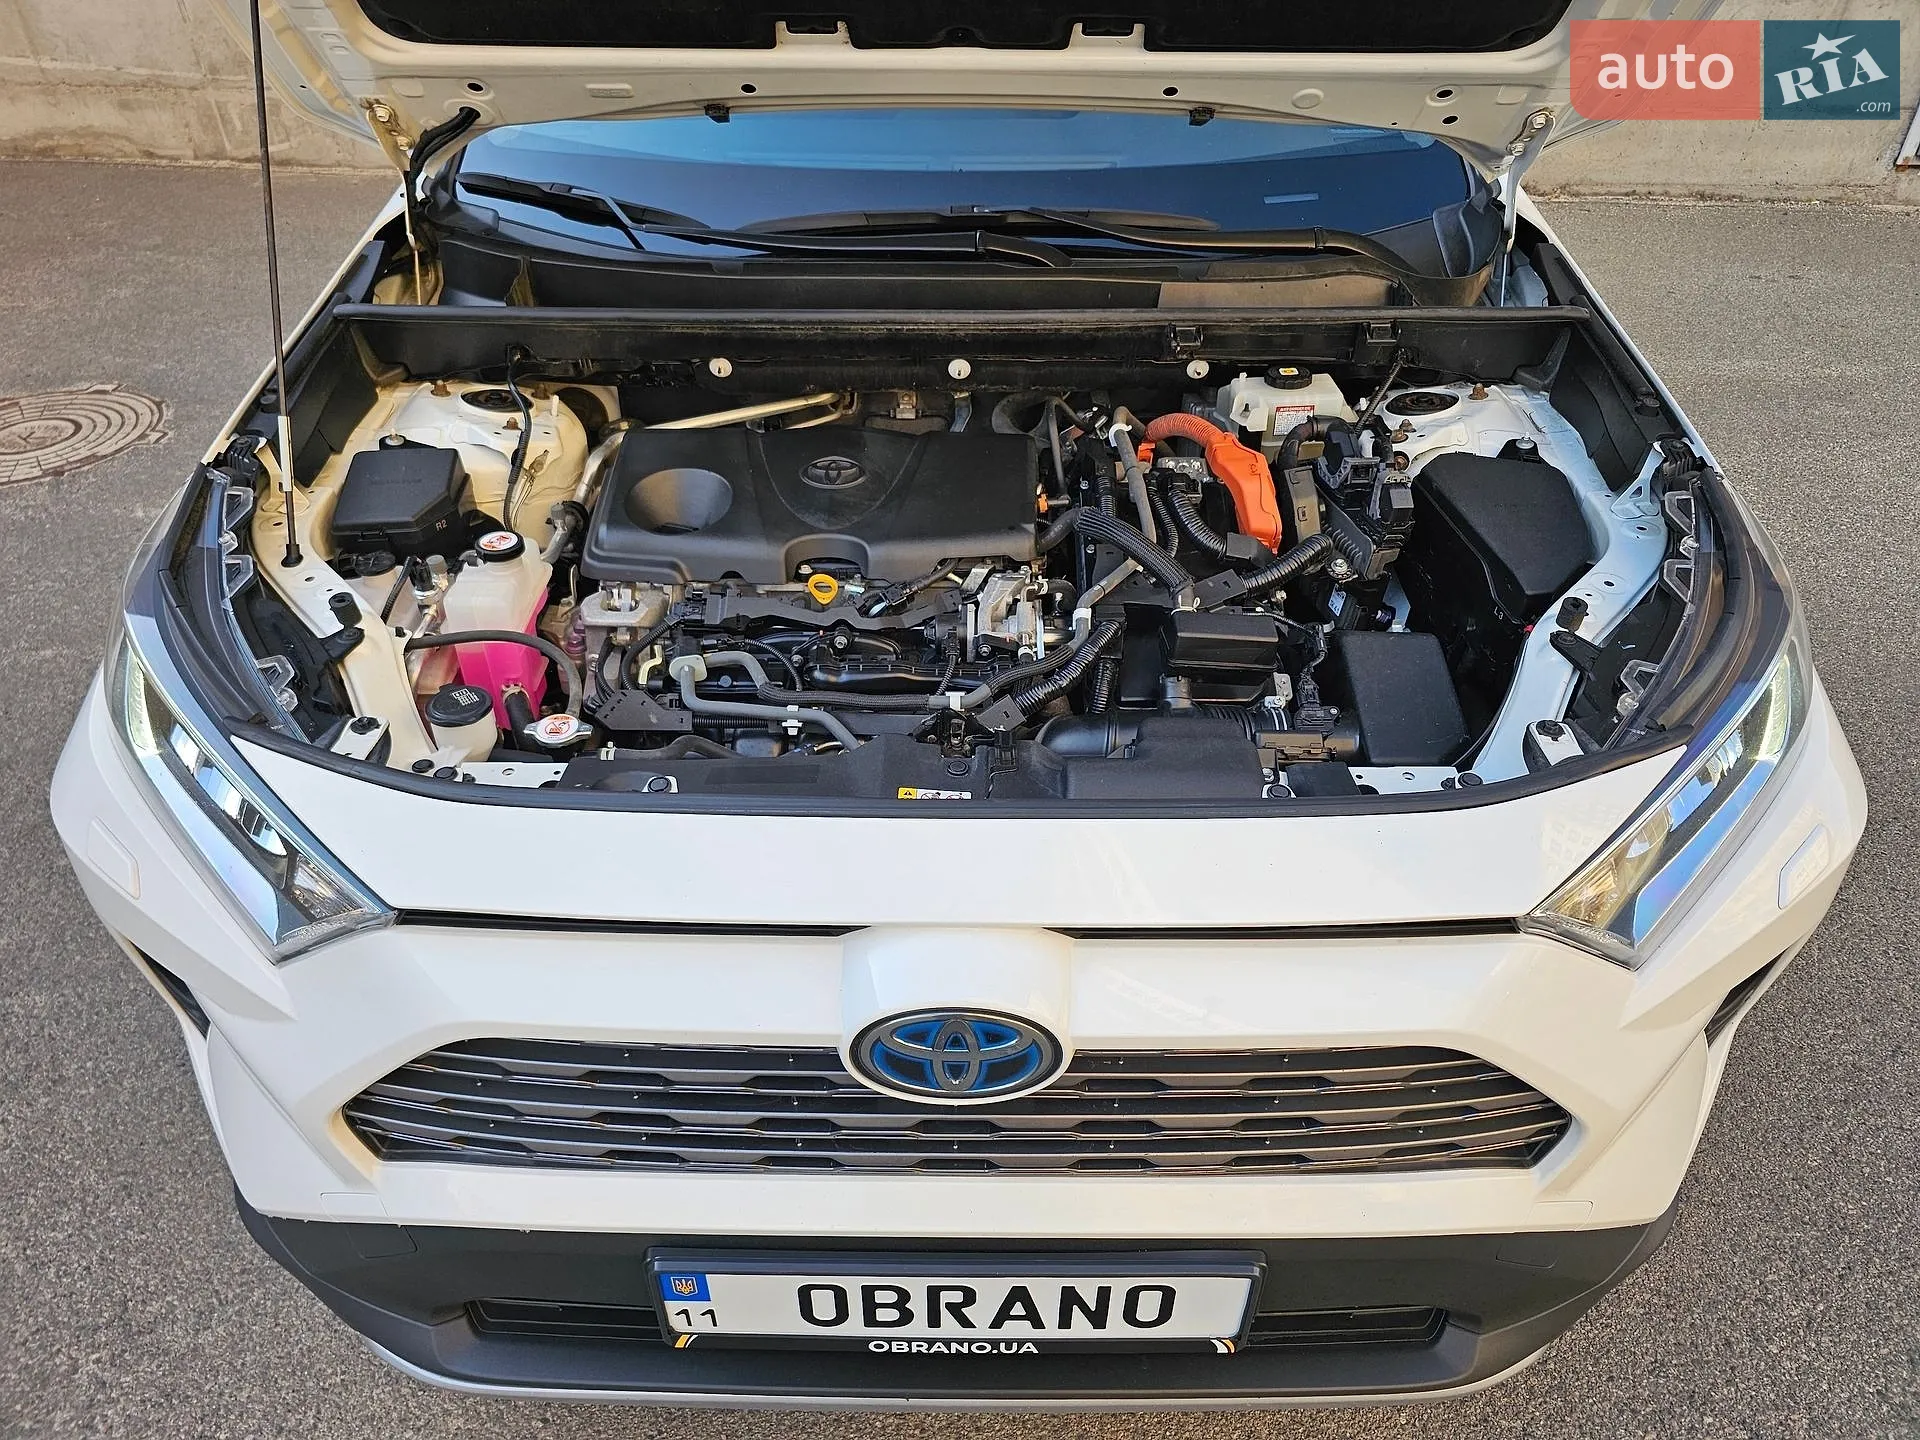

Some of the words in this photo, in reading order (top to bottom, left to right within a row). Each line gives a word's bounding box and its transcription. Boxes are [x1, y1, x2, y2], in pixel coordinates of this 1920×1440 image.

[435, 519, 448, 531] R2
[797, 1283, 1178, 1330] OBRANO
[674, 1308, 719, 1328] 11
[868, 1340, 1040, 1354] OBRANO.UA
